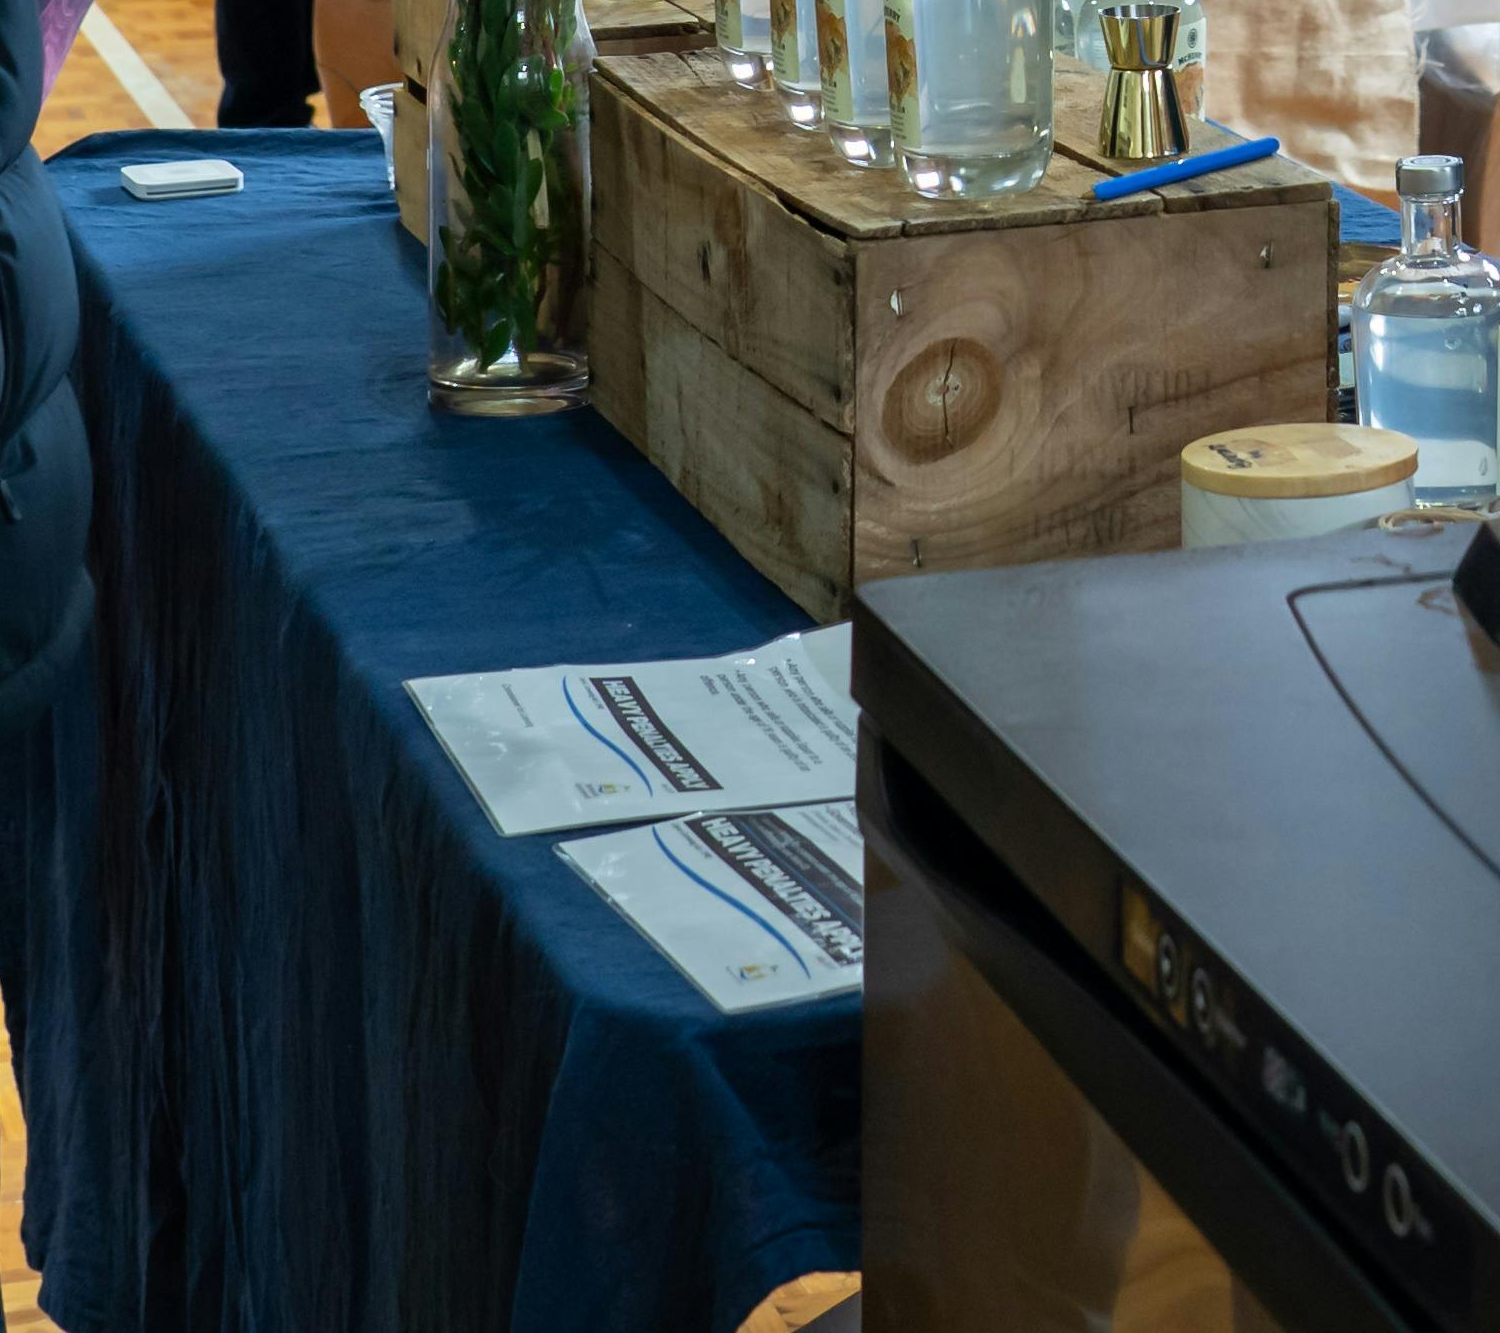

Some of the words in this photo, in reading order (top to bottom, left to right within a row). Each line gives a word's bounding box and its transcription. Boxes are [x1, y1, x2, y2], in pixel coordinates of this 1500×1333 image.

[602, 680, 644, 717] HEAVY
[626, 717, 683, 763] PENALTIES
[669, 763, 710, 789] APPLY
[701, 817, 764, 861] HEAVY
[744, 858, 831, 920] PENALTIES
